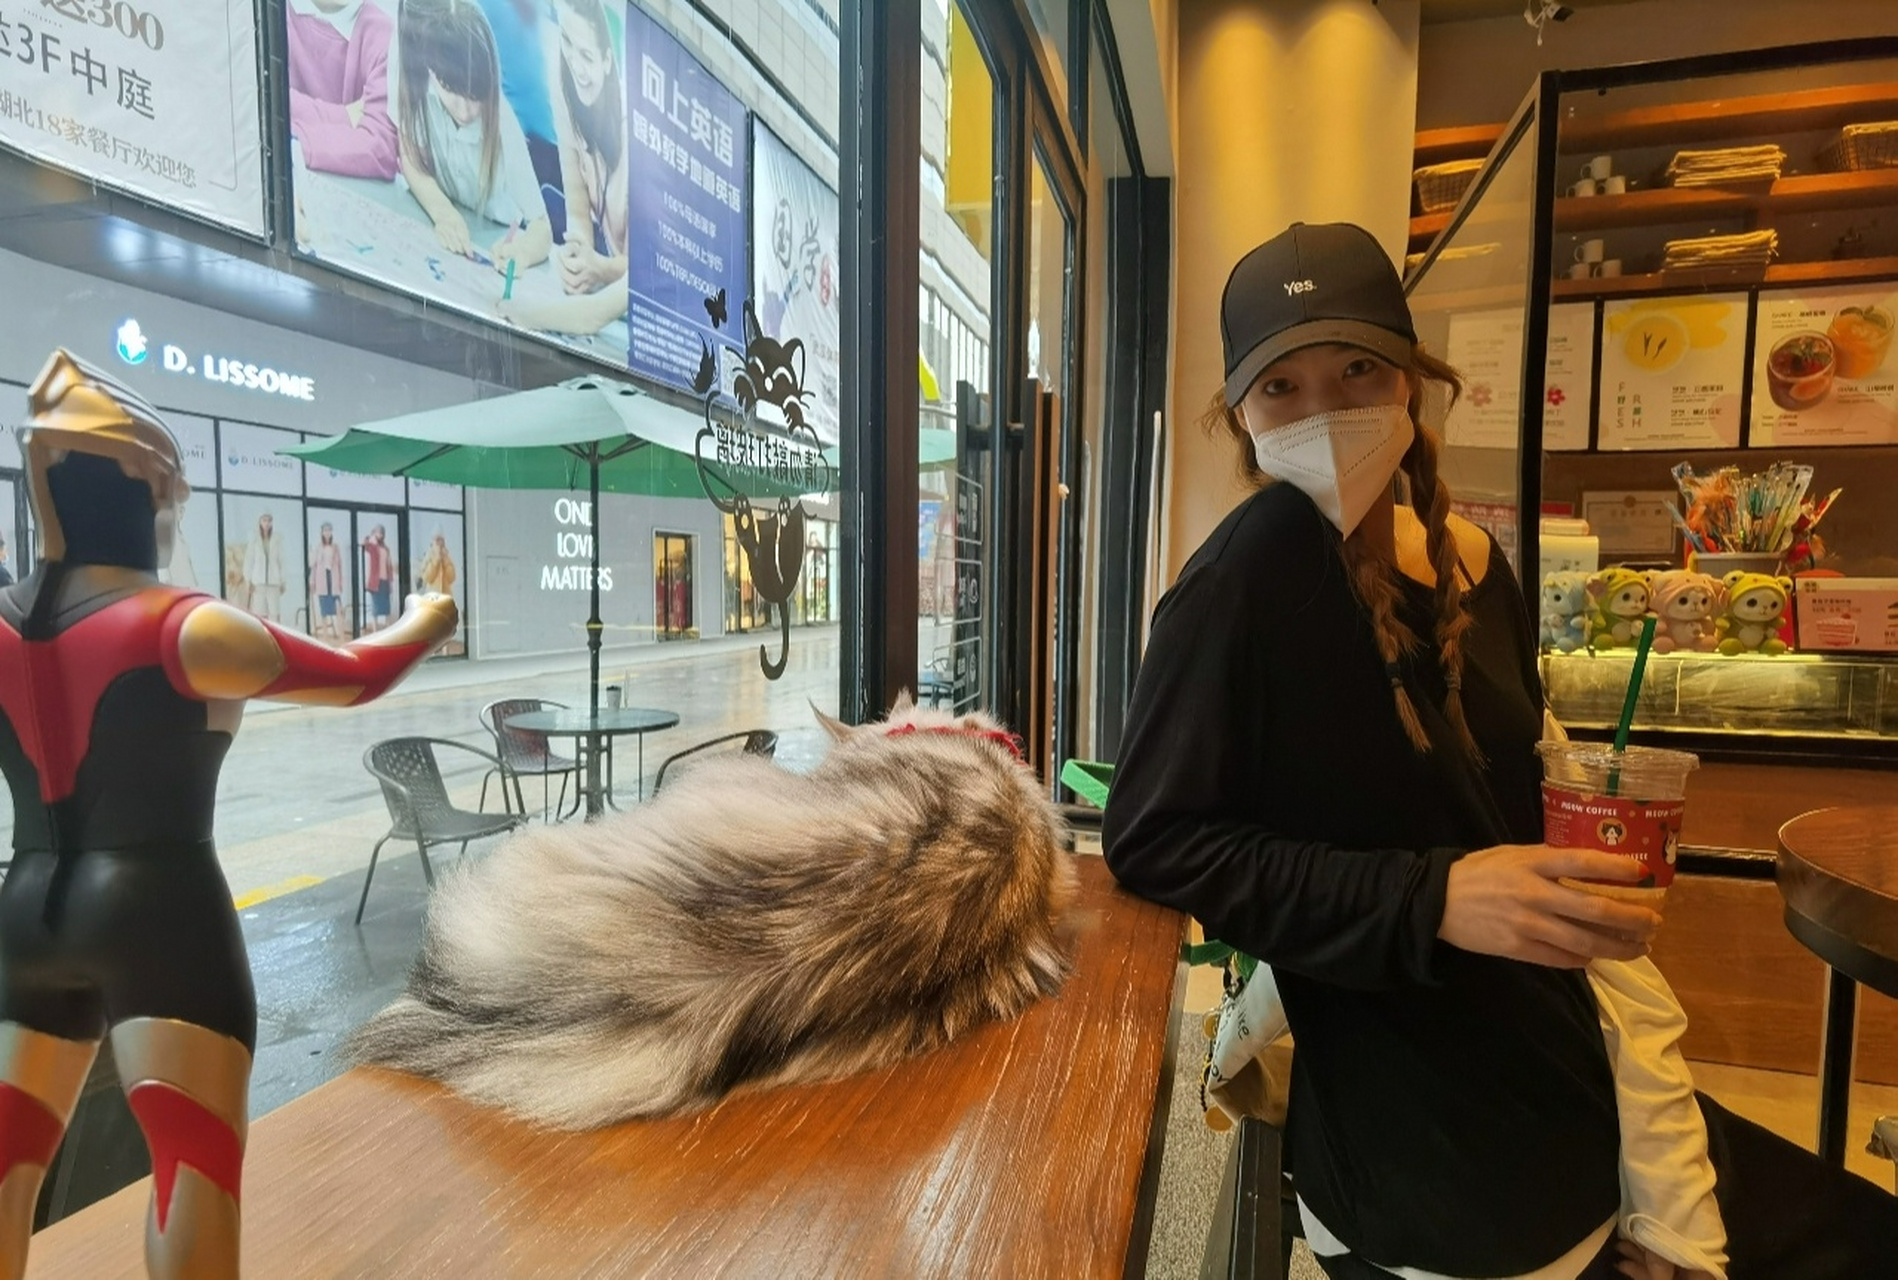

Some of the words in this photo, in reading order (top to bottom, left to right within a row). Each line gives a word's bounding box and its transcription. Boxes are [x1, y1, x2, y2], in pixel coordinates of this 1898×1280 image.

[642, 52, 733, 168] 向上英语
[163, 344, 196, 375] D.
[203, 353, 315, 401] LISSOME
[557, 532, 593, 558] LOV
[1586, 806, 1618, 818] COFFEE
